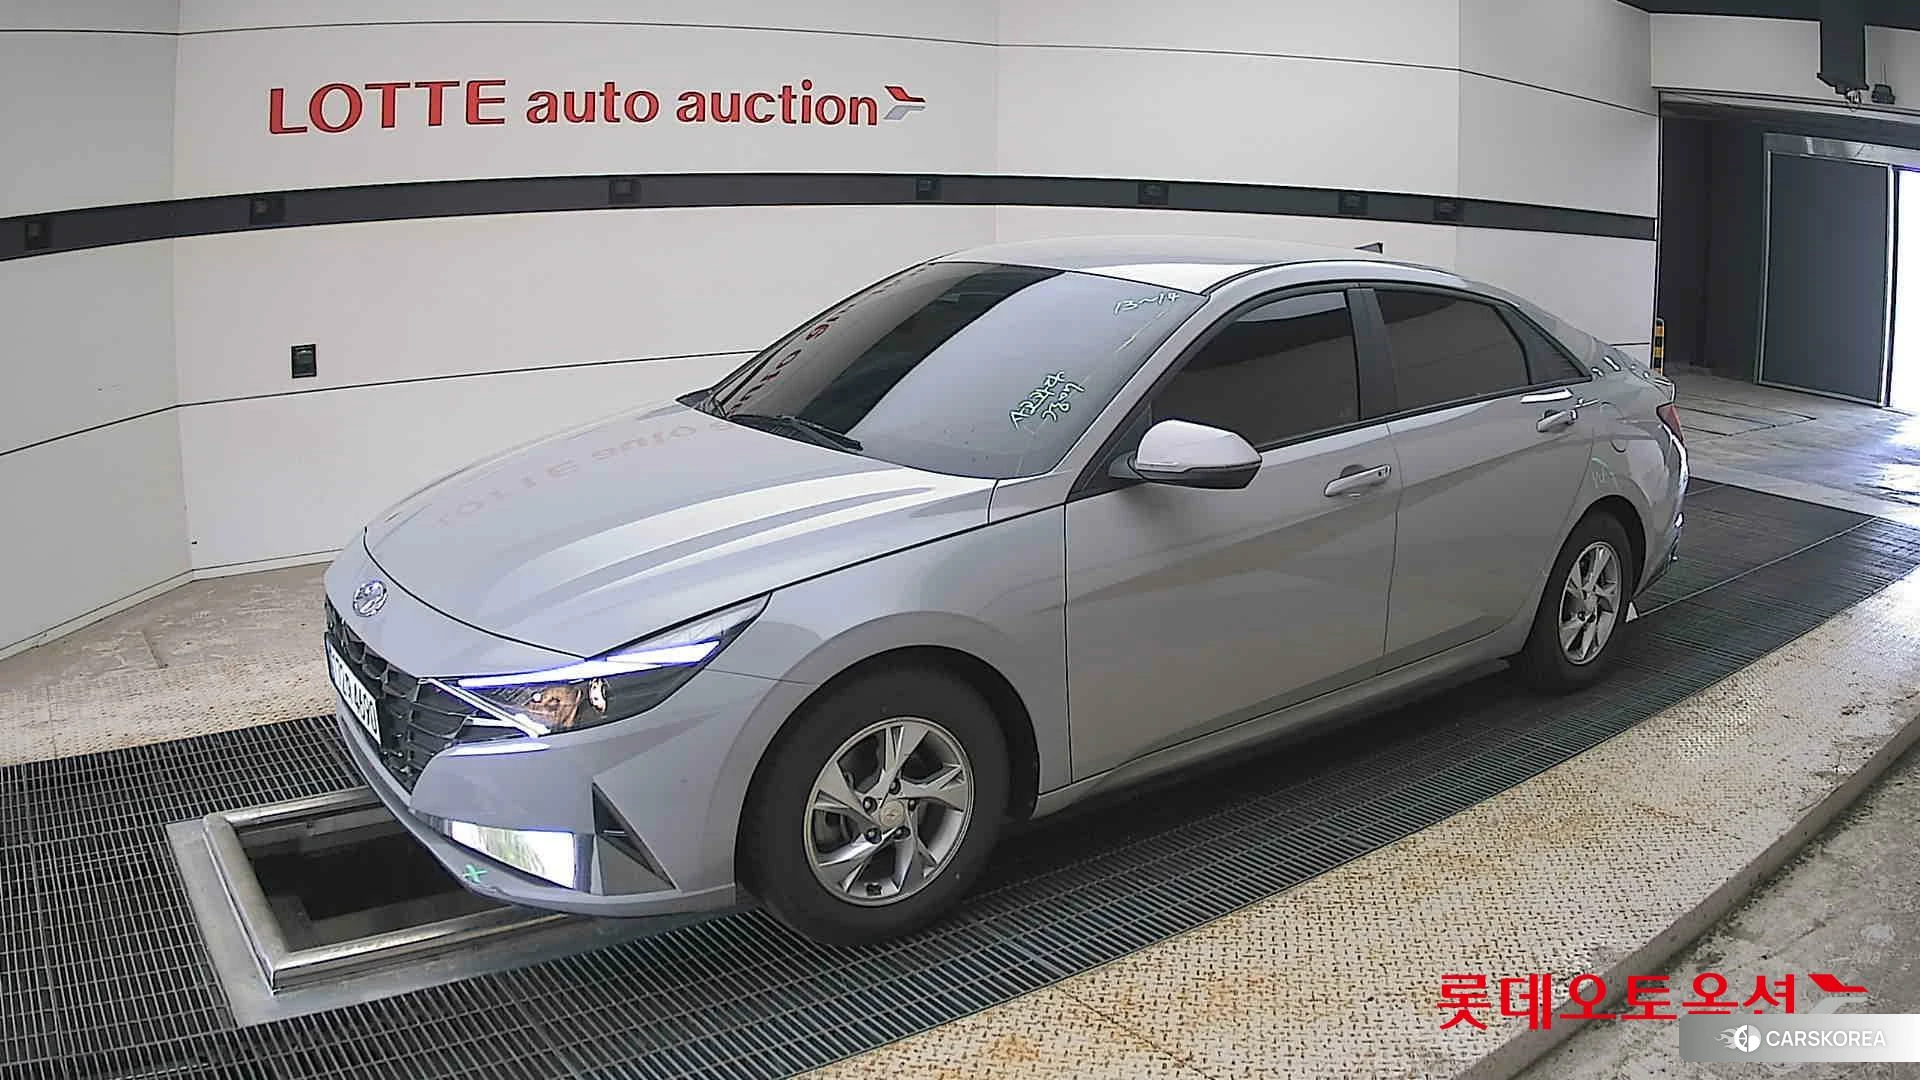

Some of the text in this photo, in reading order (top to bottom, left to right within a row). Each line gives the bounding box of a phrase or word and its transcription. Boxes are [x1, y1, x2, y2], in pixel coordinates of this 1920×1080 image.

[268, 80, 878, 135] LOTTE auto auction
